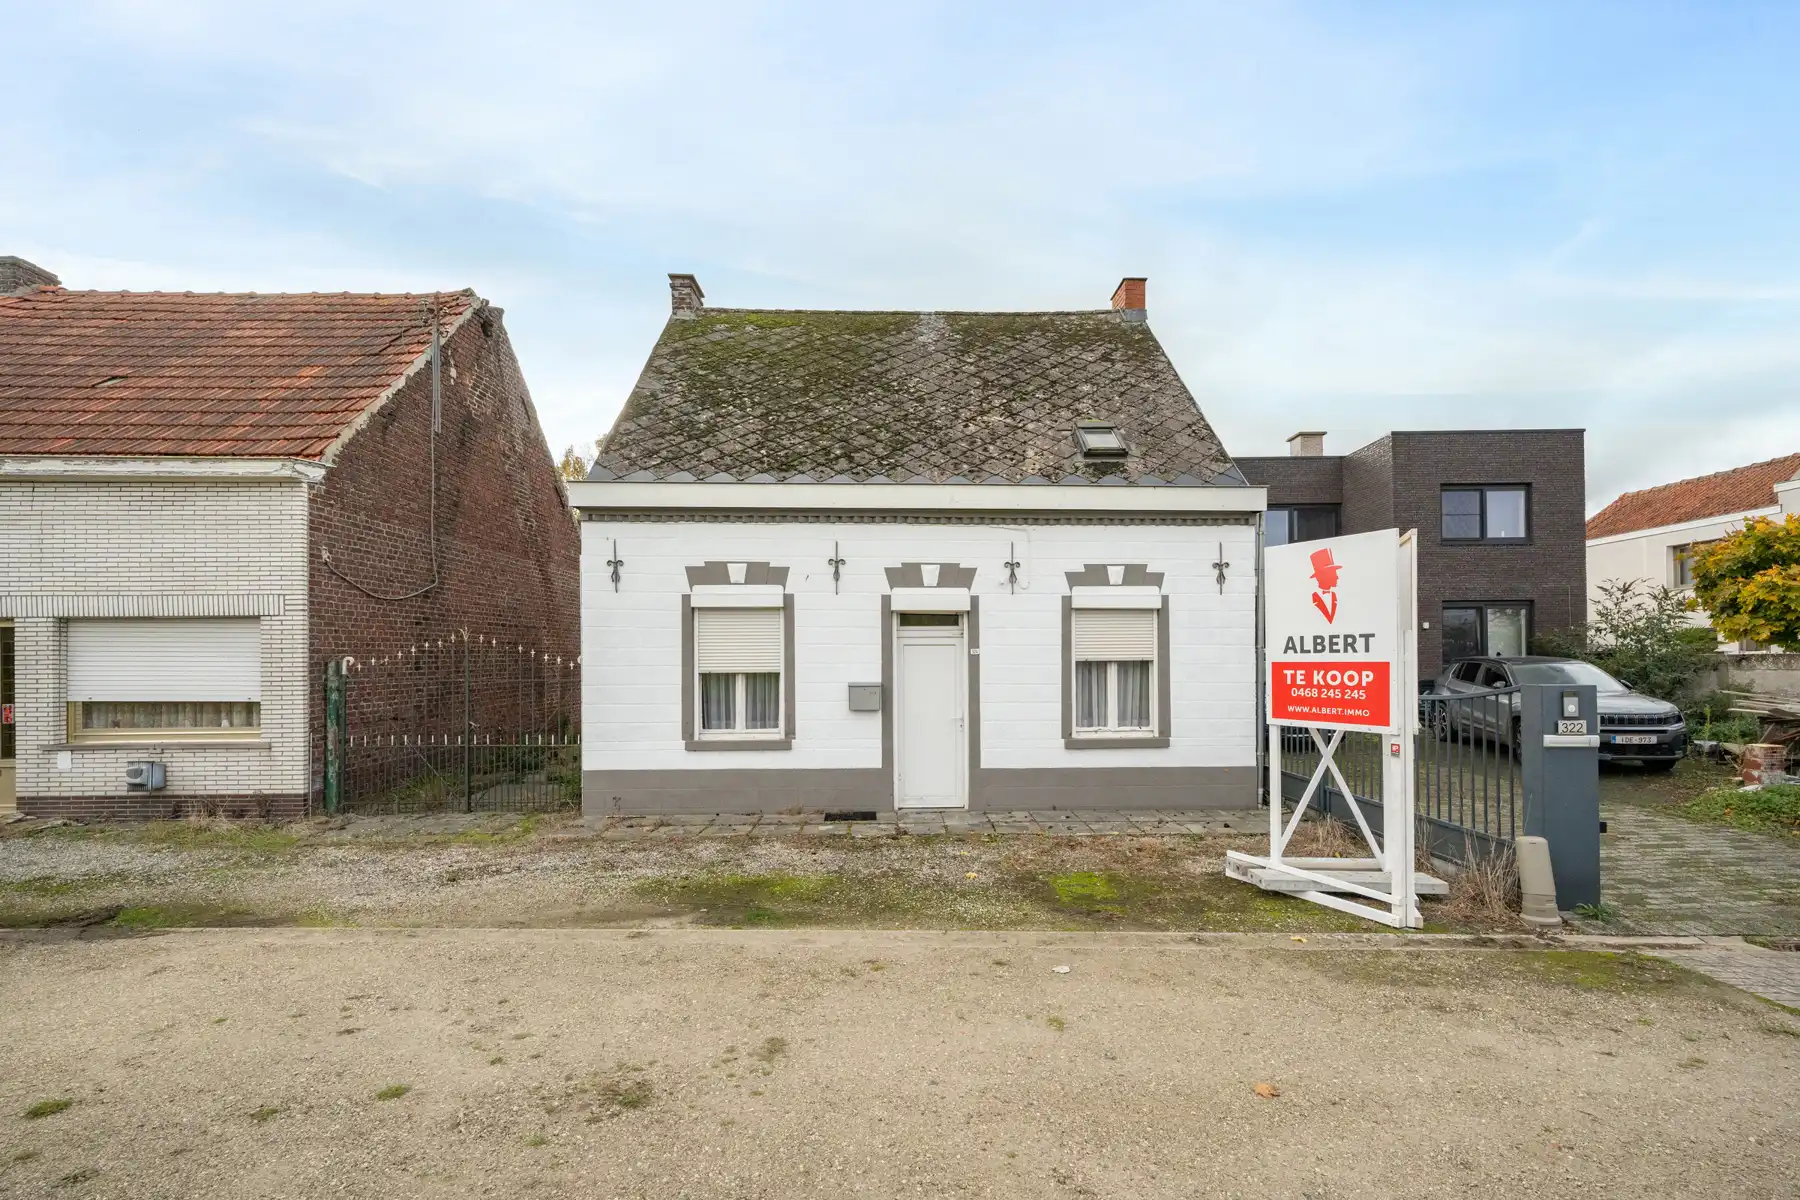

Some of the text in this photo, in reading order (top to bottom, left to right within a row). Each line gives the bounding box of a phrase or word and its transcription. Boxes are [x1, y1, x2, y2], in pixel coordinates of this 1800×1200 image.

[1283, 633, 1375, 654] ALBERT
[1283, 669, 1374, 687] TE KOOP
[1291, 687, 1366, 700] 0468 245 245
[1287, 704, 1370, 717] WWW.ALBERT.IMMO
[1561, 722, 1584, 734] 322
